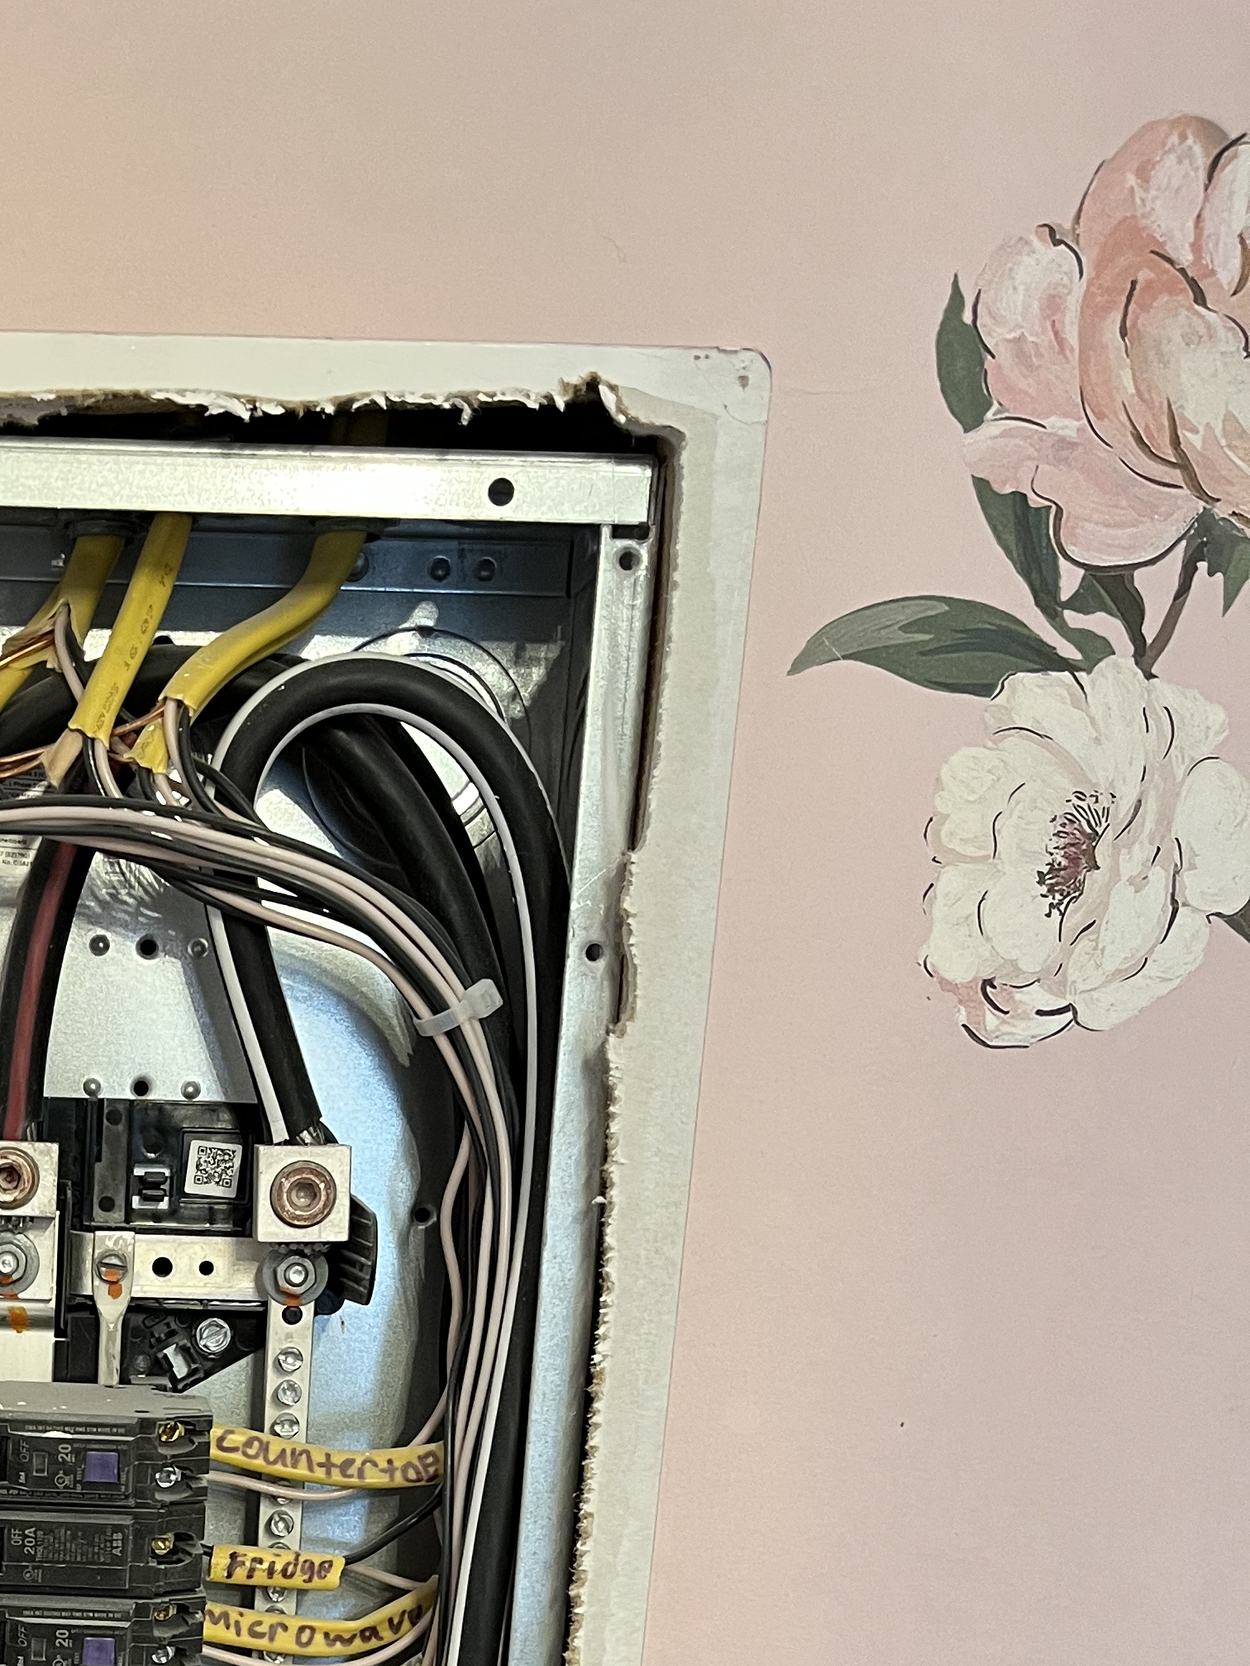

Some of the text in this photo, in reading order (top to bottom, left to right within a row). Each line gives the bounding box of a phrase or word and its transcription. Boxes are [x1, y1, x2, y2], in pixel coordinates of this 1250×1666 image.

[19, 1440, 30, 1462] OFF
[58, 1444, 72, 1462] 20
[11, 1528, 22, 1546] OFF
[24, 1527, 36, 1555] 20A
[112, 1531, 122, 1556] ABB
[18, 1624, 29, 1647] OFF
[56, 1629, 69, 1648] 20
